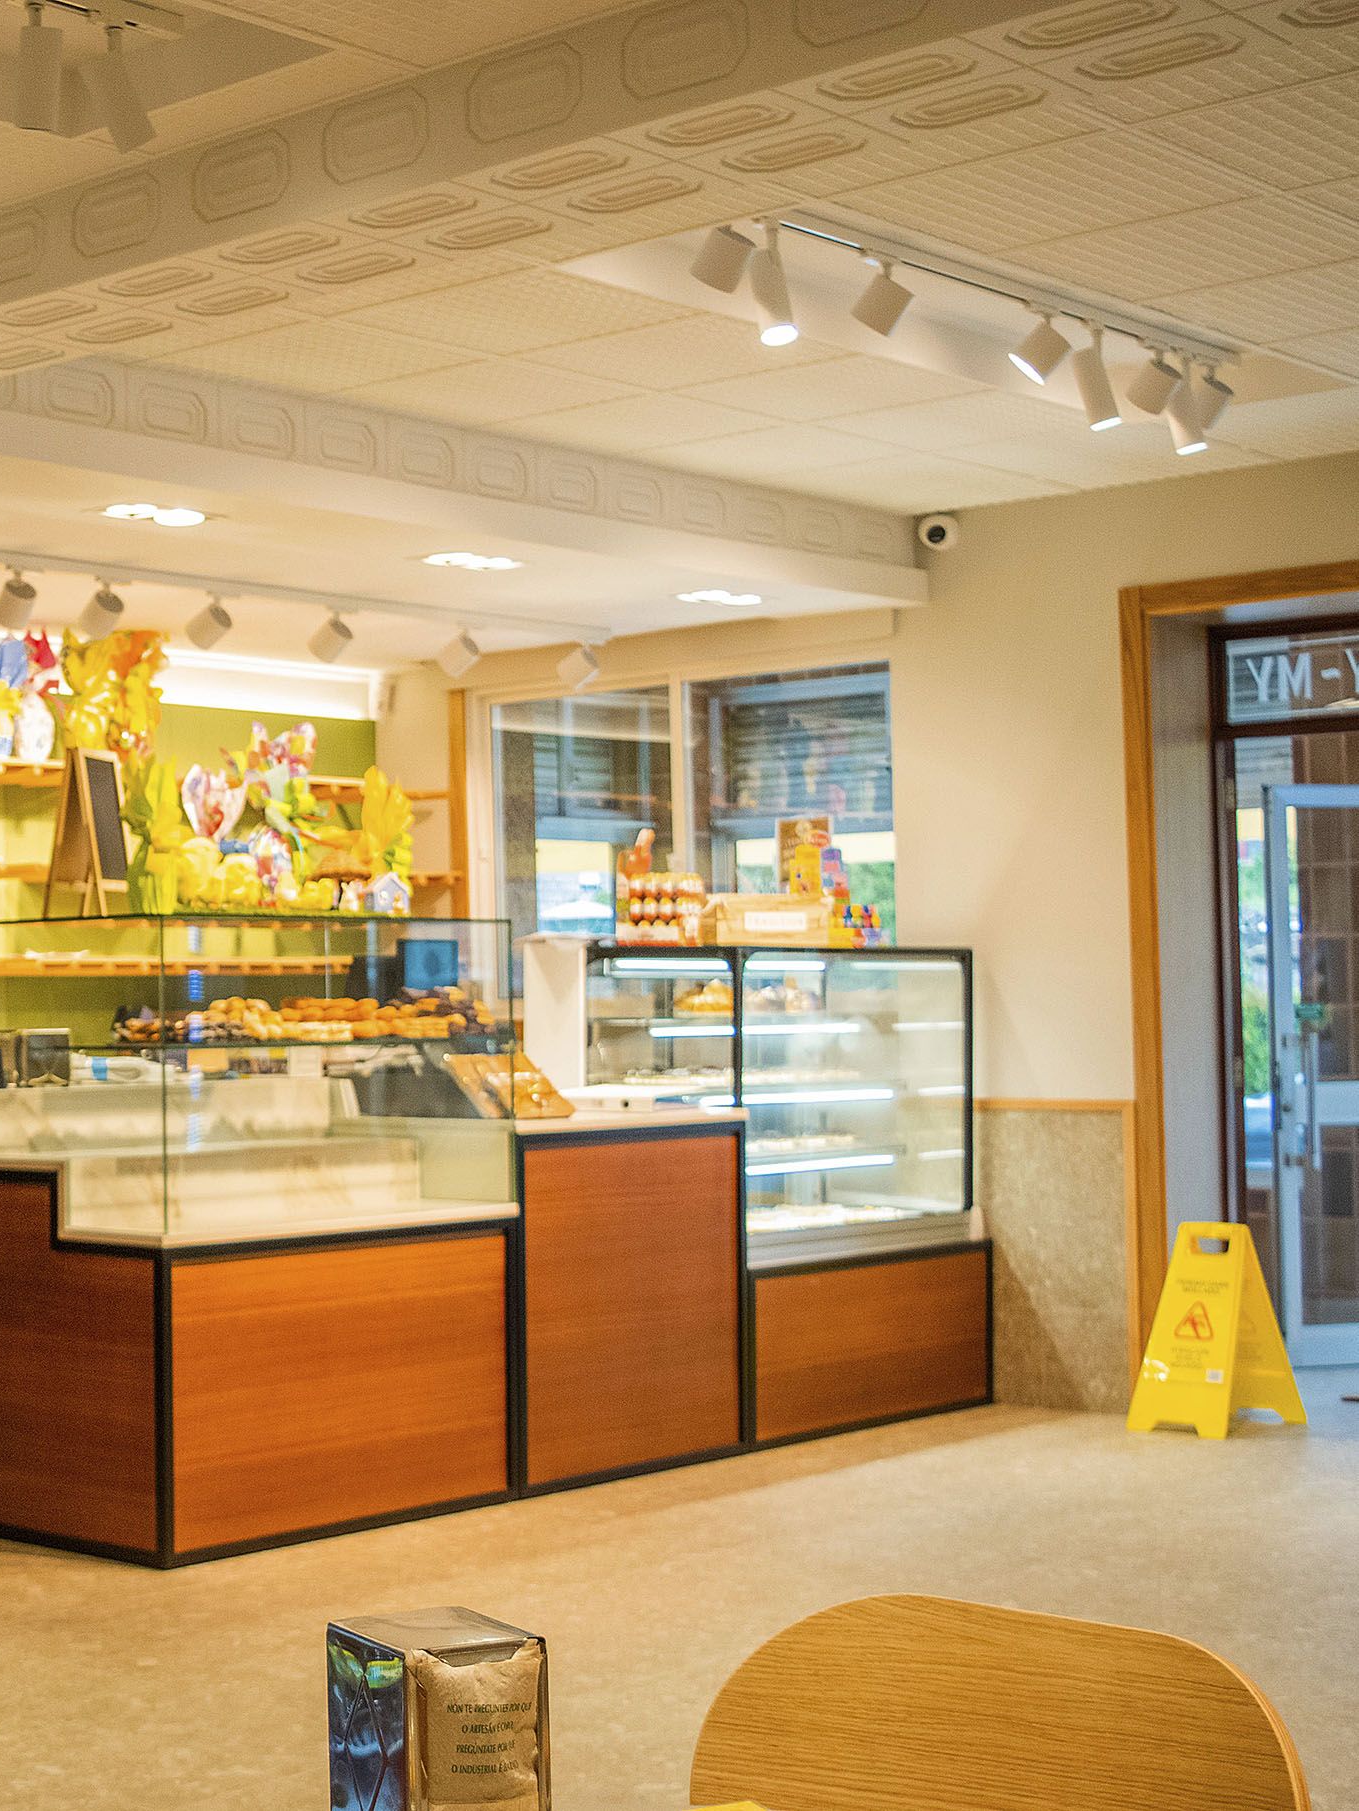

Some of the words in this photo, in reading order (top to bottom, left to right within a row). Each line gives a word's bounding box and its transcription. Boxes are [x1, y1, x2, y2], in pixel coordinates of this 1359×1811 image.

[446, 1704, 463, 1713] NON
[465, 1704, 472, 1713] TE
[461, 1724, 468, 1733] O
[451, 1764, 458, 1773] O
